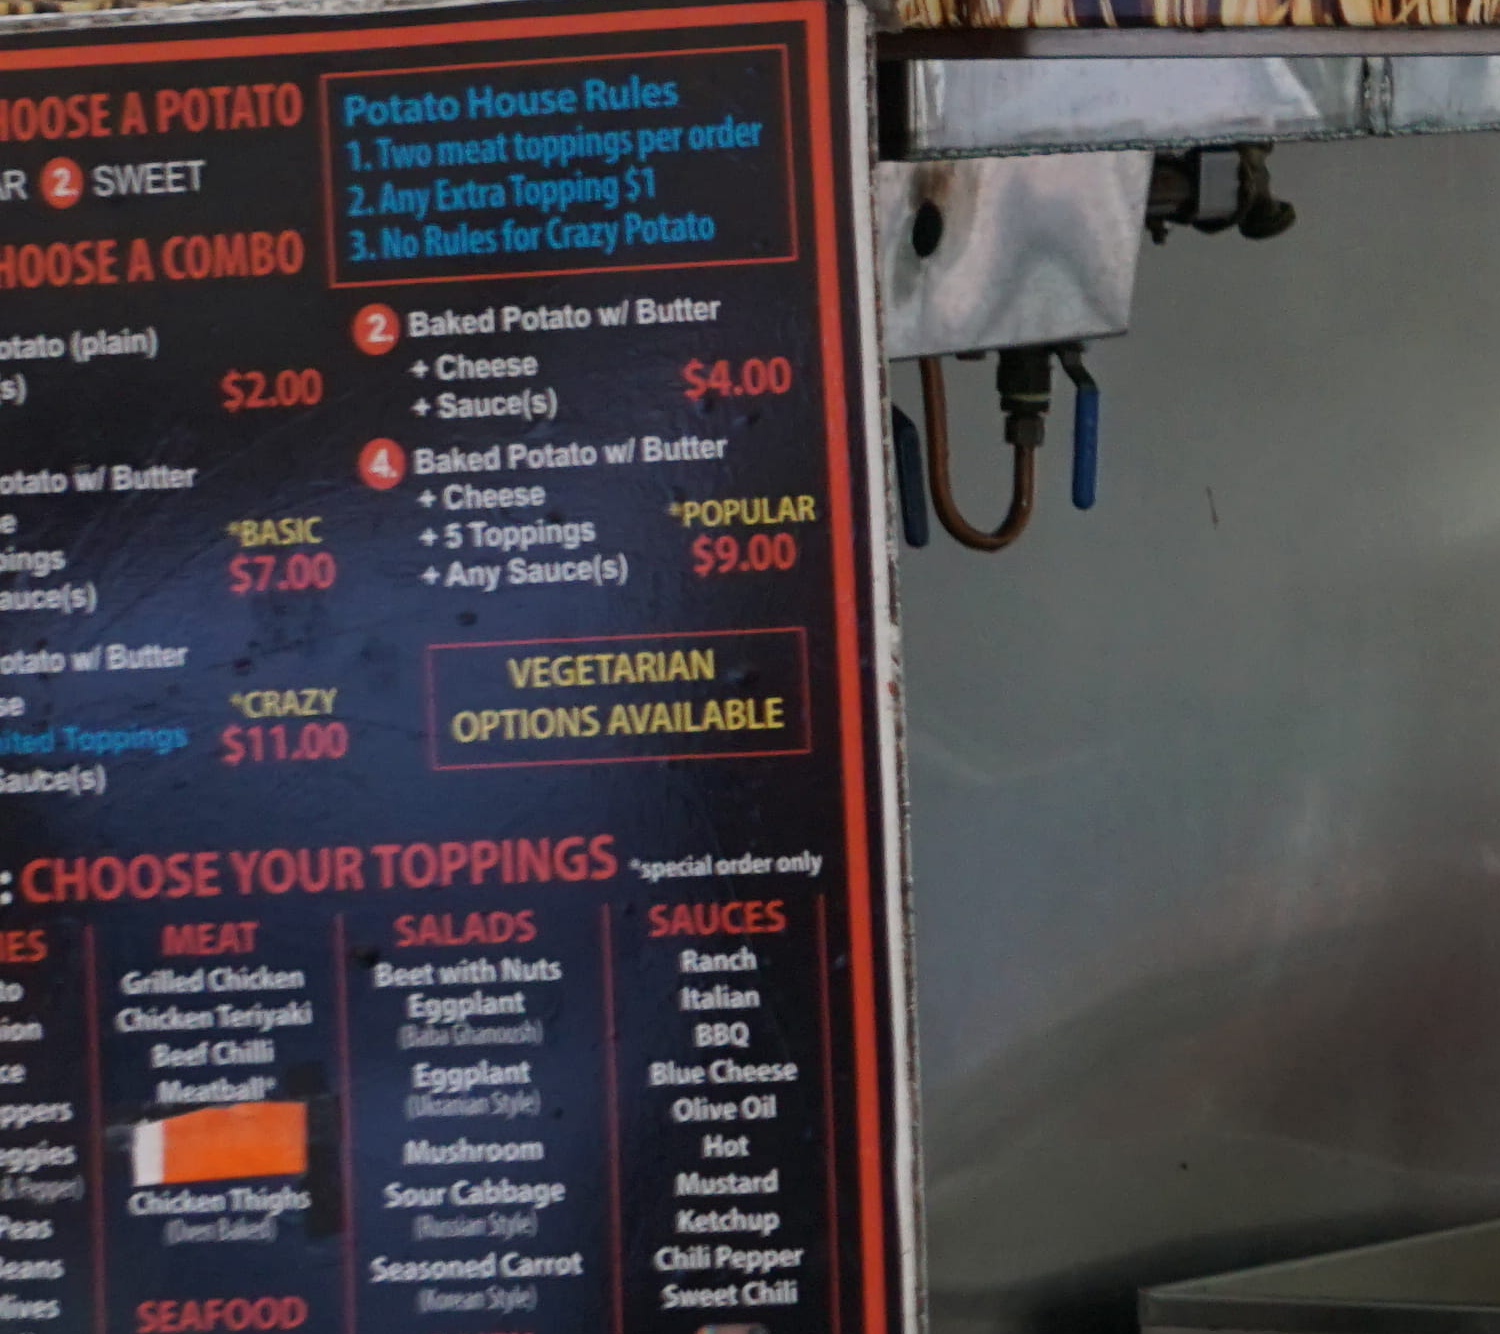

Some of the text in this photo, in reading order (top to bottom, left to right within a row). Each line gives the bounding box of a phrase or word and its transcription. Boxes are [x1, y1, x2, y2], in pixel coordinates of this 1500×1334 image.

[120, 91, 148, 136] A
[155, 82, 303, 134] POTATO
[343, 75, 679, 127] Potato House Rules
[346, 114, 763, 171] 1. Two meat toppings per order
[92, 160, 207, 197] SWEET
[348, 166, 657, 221] 2. Any Extra Topping $1
[349, 211, 717, 261] 3. No Rules for Crazy Potato
[127, 238, 155, 283] A
[161, 230, 305, 280] COMBO
[408, 307, 496, 338] Baked
[502, 303, 592, 333] Potato
[598, 300, 629, 329] w/
[635, 297, 721, 325] Butter
[70, 326, 159, 362] (plain)
[435, 354, 539, 382] Cheese
[681, 357, 793, 401] $4.00
[220, 369, 325, 413] $2.00
[437, 388, 560, 423] Sauce(s)
[414, 444, 502, 476] Baked
[507, 440, 598, 471] Potato
[604, 437, 635, 466] w/
[641, 434, 729, 463] Butter
[72, 466, 106, 492] w/
[110, 465, 199, 491] Butter
[442, 485, 547, 511] Cheese
[444, 519, 597, 553] 5 Toppings
[691, 532, 798, 578] $9.00
[228, 552, 338, 596] $7.00
[445, 553, 630, 593] Any Sauce(s)
[71, 645, 103, 672] w/
[105, 643, 189, 670] Butter
[507, 648, 716, 689] VEGETARIAN
[451, 697, 785, 744] OPTIONS AVAILABLE
[62, 724, 189, 756] Toppings
[219, 722, 350, 766] $11.00
[19, 851, 224, 903] CHOOSE
[229, 845, 366, 895] YOUR
[370, 834, 619, 890] TOPPINGS
[715, 851, 772, 876] order
[776, 849, 823, 877] only
[395, 909, 539, 947] SALADS
[648, 899, 787, 937] SAUCES
[161, 921, 260, 957] MEAT
[374, 957, 563, 988] Beet with Nuts
[680, 945, 758, 974] Ranch
[207, 965, 306, 992] Chicken
[407, 989, 527, 1024] Eggplant
[679, 984, 761, 1011] Italian
[694, 1022, 750, 1048] BBQ
[413, 1059, 532, 1094] Eggplant
[649, 1057, 799, 1086] Blue Cheese
[672, 1094, 777, 1123] Olive Oil
[403, 1137, 545, 1165] Mushroom
[703, 1134, 751, 1158] Hot
[383, 1177, 567, 1209] Sour Cabbage
[676, 1168, 780, 1196] Mustard
[677, 1207, 781, 1237] Ketchup
[369, 1252, 585, 1283] Seasoned Carrot
[654, 1245, 805, 1274] Chili Pepper
[662, 1279, 798, 1310] Sweet Chili
[136, 1295, 309, 1334] SEAFOOD
